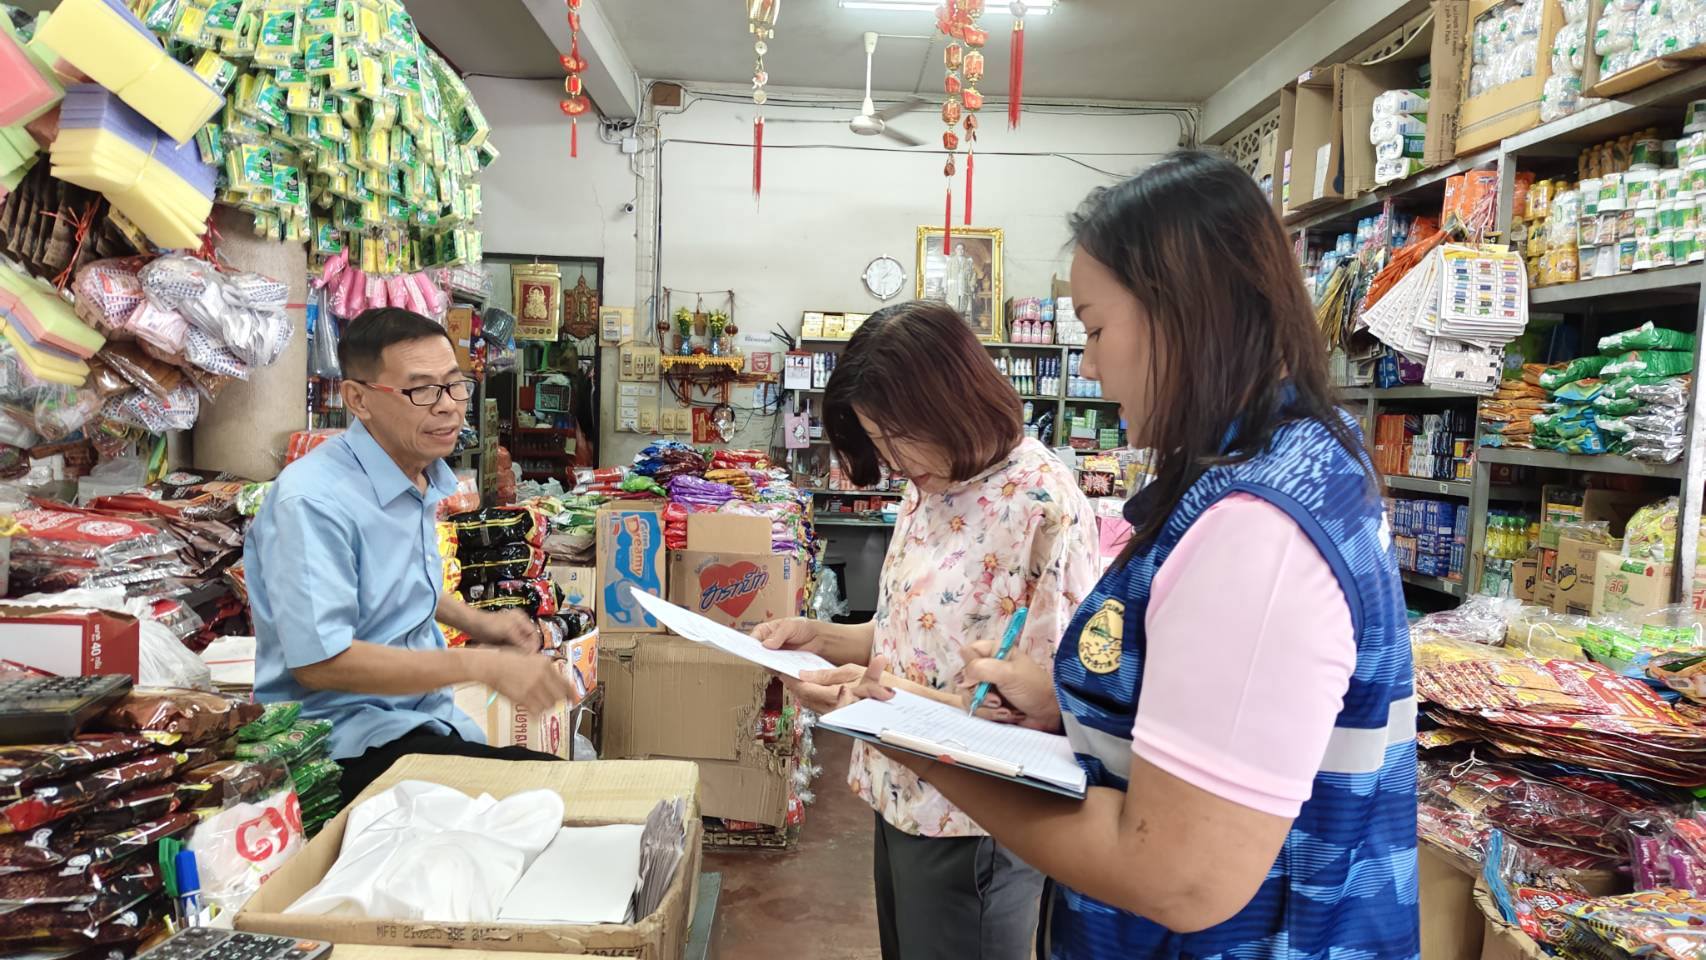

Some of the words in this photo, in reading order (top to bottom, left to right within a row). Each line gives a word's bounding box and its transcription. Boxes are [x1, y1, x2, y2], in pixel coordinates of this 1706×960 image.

[792, 356, 804, 367] 14
[624, 516, 643, 577] Dreamy
[91, 642, 101, 656] 40
